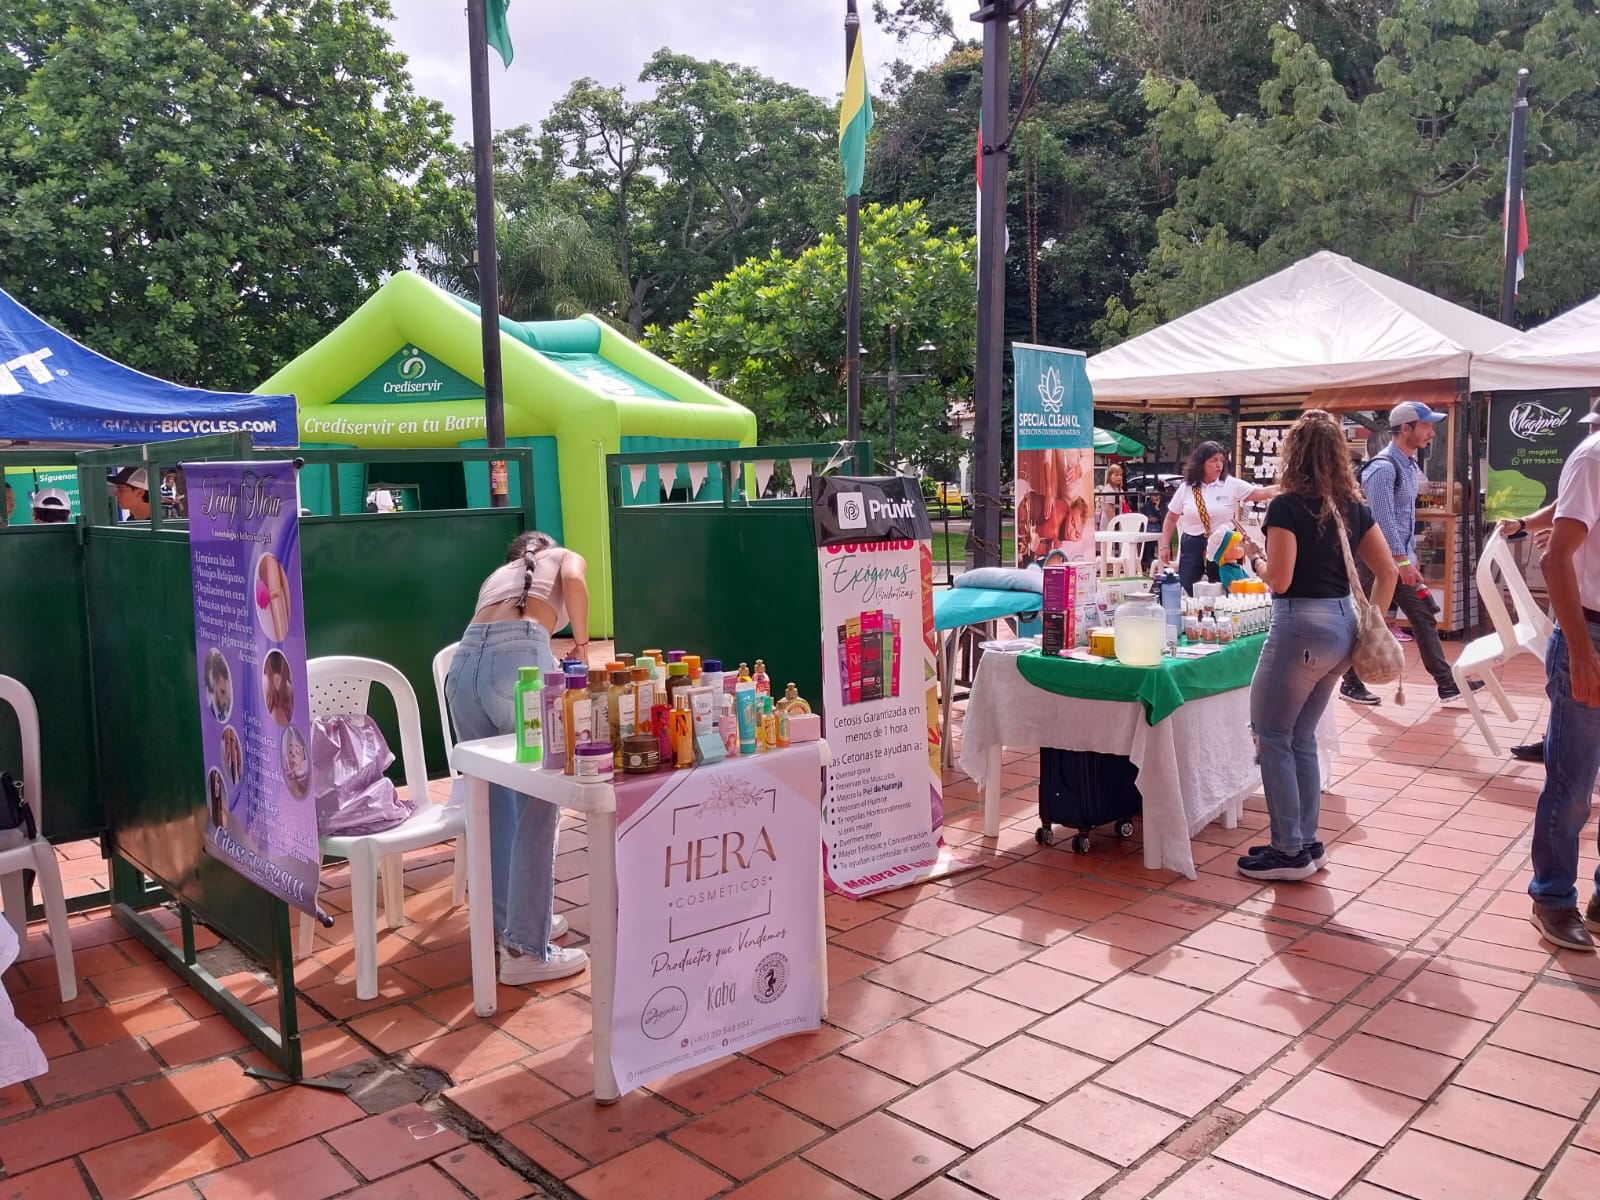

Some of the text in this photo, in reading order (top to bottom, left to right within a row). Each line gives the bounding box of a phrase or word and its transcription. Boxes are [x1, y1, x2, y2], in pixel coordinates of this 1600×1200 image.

[383, 380, 443, 394] Crediservir
[304, 417, 395, 435] Crediservir
[399, 421, 418, 434] en
[422, 418, 439, 433] tu
[1018, 412, 1047, 427] SPECIAL
[1048, 414, 1071, 427] CLEAN
[1511, 405, 1572, 436] Magipiel
[1528, 448, 1558, 456] magipiel
[868, 497, 915, 519] Prüvit
[196, 550, 234, 568] Limpieza facial
[834, 706, 920, 729] Cetosis Garantizada en
[845, 732, 872, 744] menos
[873, 727, 883, 738] de
[890, 722, 908, 734] hora
[842, 750, 874, 766] Cetonas
[874, 748, 882, 758] te
[884, 744, 912, 760] ayudan
[914, 742, 923, 751] a:
[857, 766, 870, 777] grasa
[836, 780, 862, 791] Preservan
[836, 792, 856, 803] Mejora
[862, 786, 872, 796] Piel
[874, 784, 882, 793] de
[882, 780, 903, 792] Naranja
[838, 816, 844, 824] Te
[866, 802, 912, 817] Hormonalmente
[856, 822, 873, 832] mujer
[214, 826, 245, 865] Citas:
[839, 830, 882, 848] Duermes mejor
[664, 825, 777, 888] HERA
[838, 848, 858, 860] Mayor
[858, 842, 882, 854] Enfoque
[840, 861, 848, 870] Te
[848, 856, 871, 870] ayudan
[876, 848, 902, 861] controlar
[844, 870, 897, 890] Mejora
[892, 864, 913, 874] tu
[651, 925, 788, 979] Productos que Vendemos
[706, 980, 737, 1012] Kaba
[782, 1015, 807, 1026] Ocaña
[711, 1028, 722, 1039] 312
